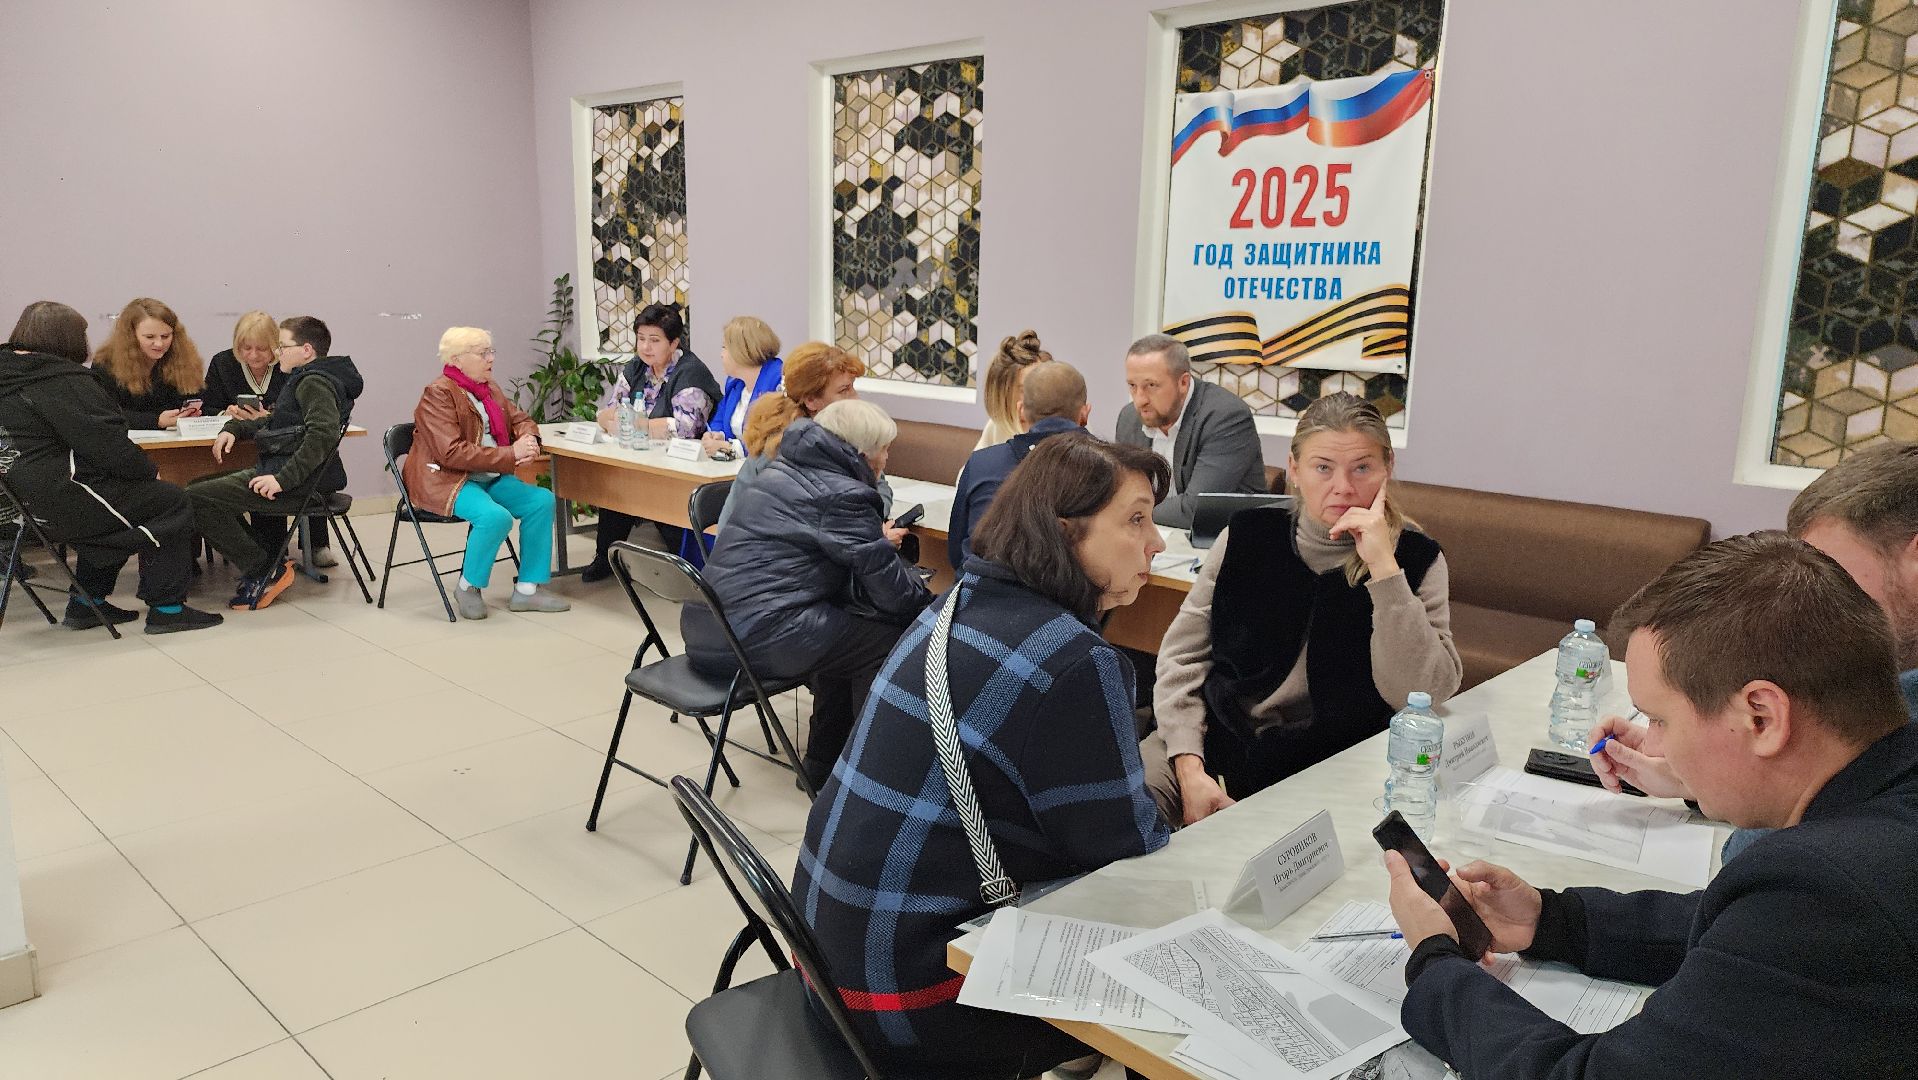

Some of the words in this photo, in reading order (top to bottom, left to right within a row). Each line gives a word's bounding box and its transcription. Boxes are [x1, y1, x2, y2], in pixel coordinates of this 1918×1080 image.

[1229, 163, 1352, 229] 2025
[1193, 243, 1233, 269] ГОД
[1244, 241, 1381, 269] ЗАЩИТНИКА
[1224, 277, 1342, 300] ОТЕЧЕСТВА
[1273, 868, 1293, 885] Игорь
[1293, 842, 1328, 873] Дмитриевич
[1277, 832, 1317, 866] СУРОВИКОВ
